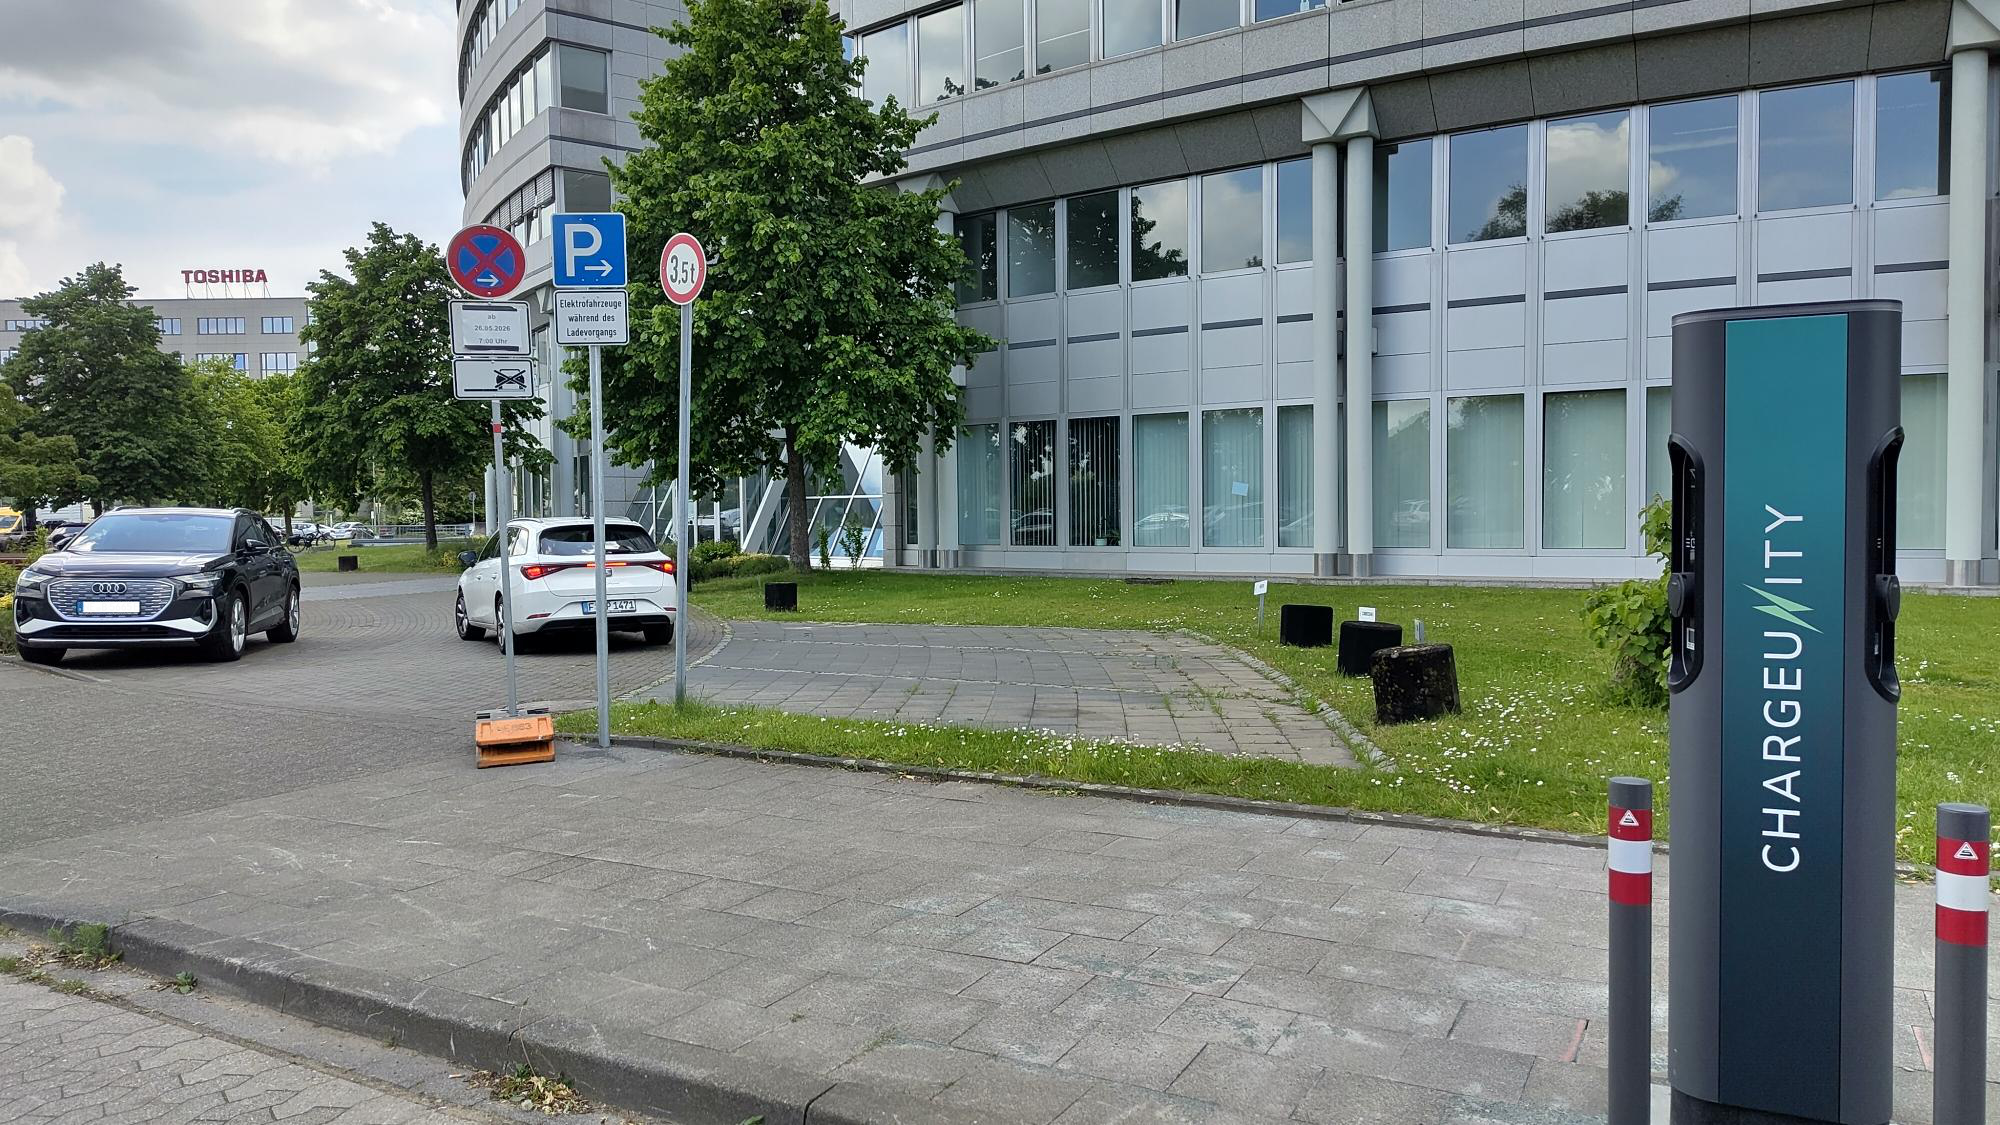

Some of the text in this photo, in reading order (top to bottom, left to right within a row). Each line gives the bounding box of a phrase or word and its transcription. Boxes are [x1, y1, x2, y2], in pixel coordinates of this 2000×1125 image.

[564, 223, 602, 277] P
[181, 269, 268, 283] TOSHIBA
[559, 299, 622, 310] Elektrofahrzeuge
[567, 312, 616, 322] während des
[566, 327, 617, 338] Ladevorgangs
[613, 600, 634, 610] 1471
